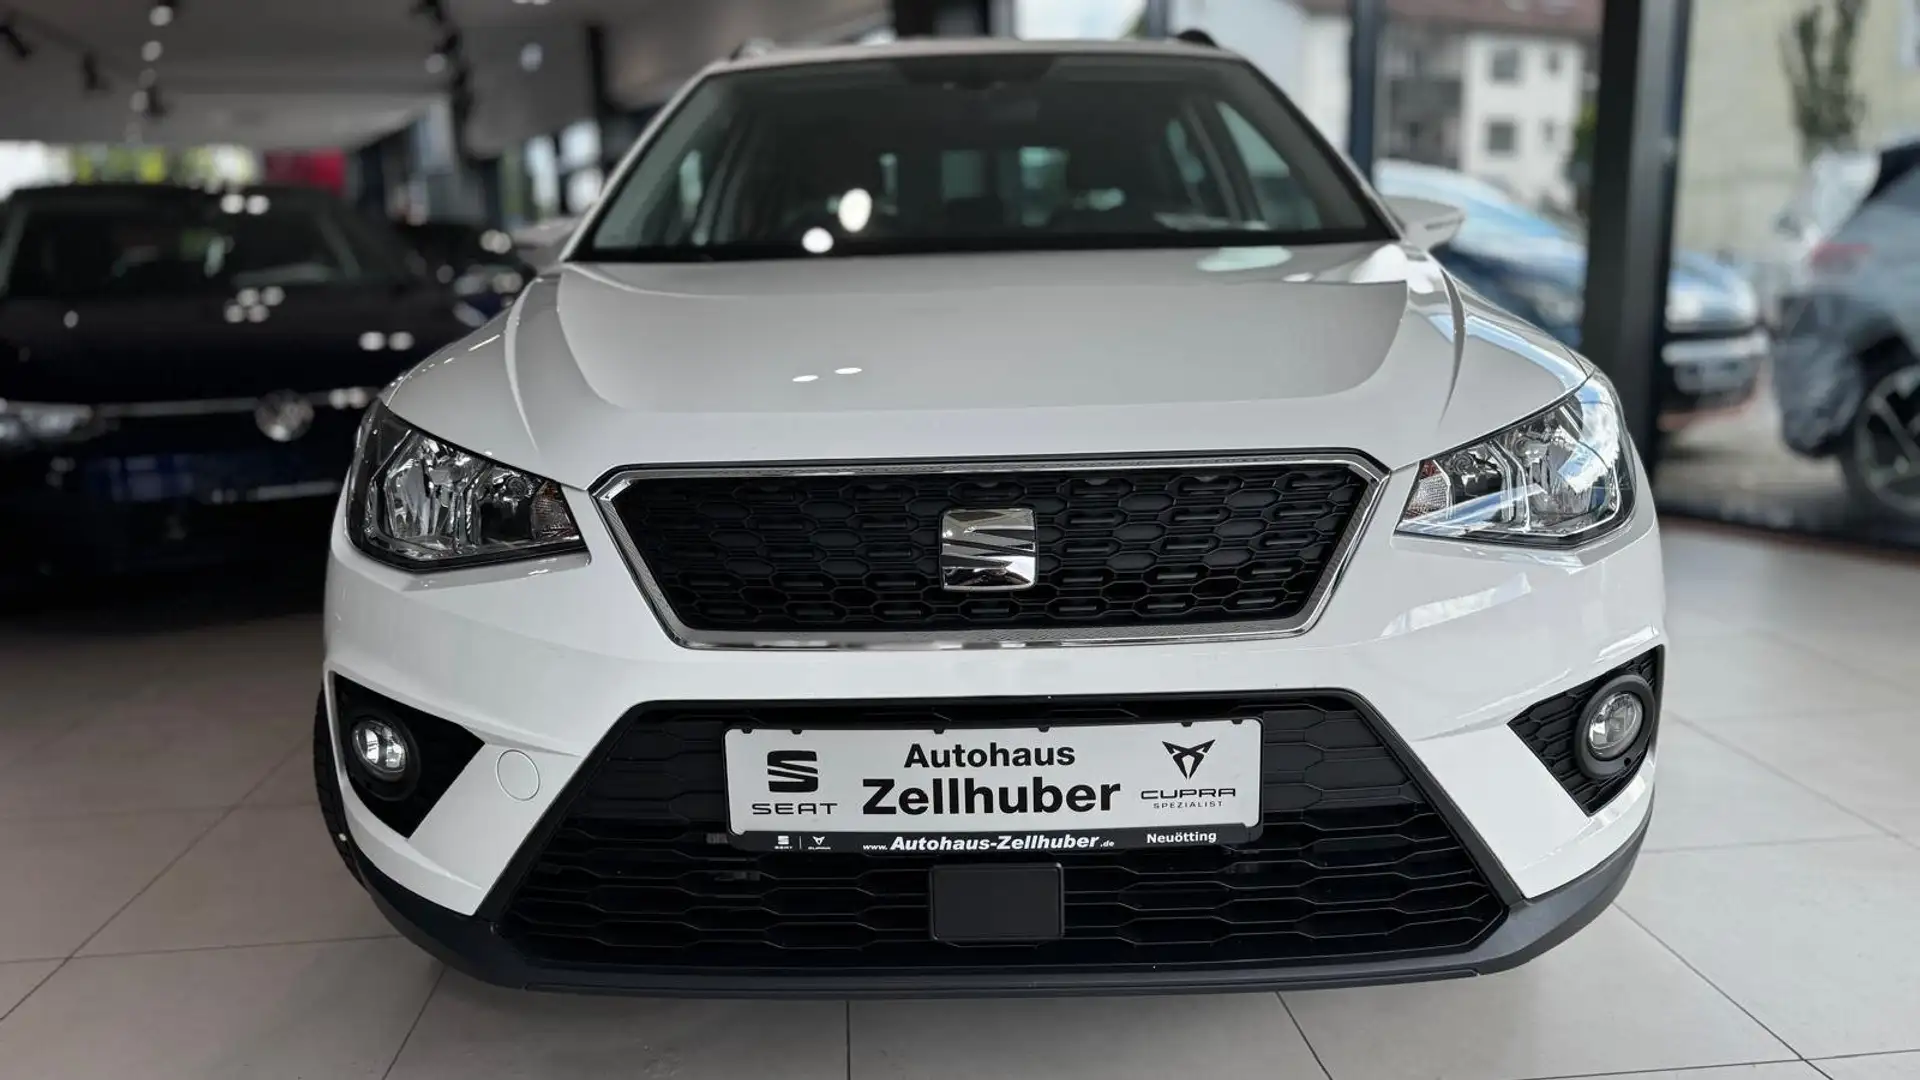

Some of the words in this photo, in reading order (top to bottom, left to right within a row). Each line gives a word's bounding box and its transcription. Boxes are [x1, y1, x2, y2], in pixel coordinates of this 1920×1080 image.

[904, 742, 1075, 768] Autohaus
[862, 777, 1121, 815] Zellhuber
[1140, 788, 1236, 800] CUPRA
[752, 803, 838, 815] SEAT
[1153, 801, 1223, 809] SPEZIALIST
[1147, 831, 1217, 843] Neuötting
